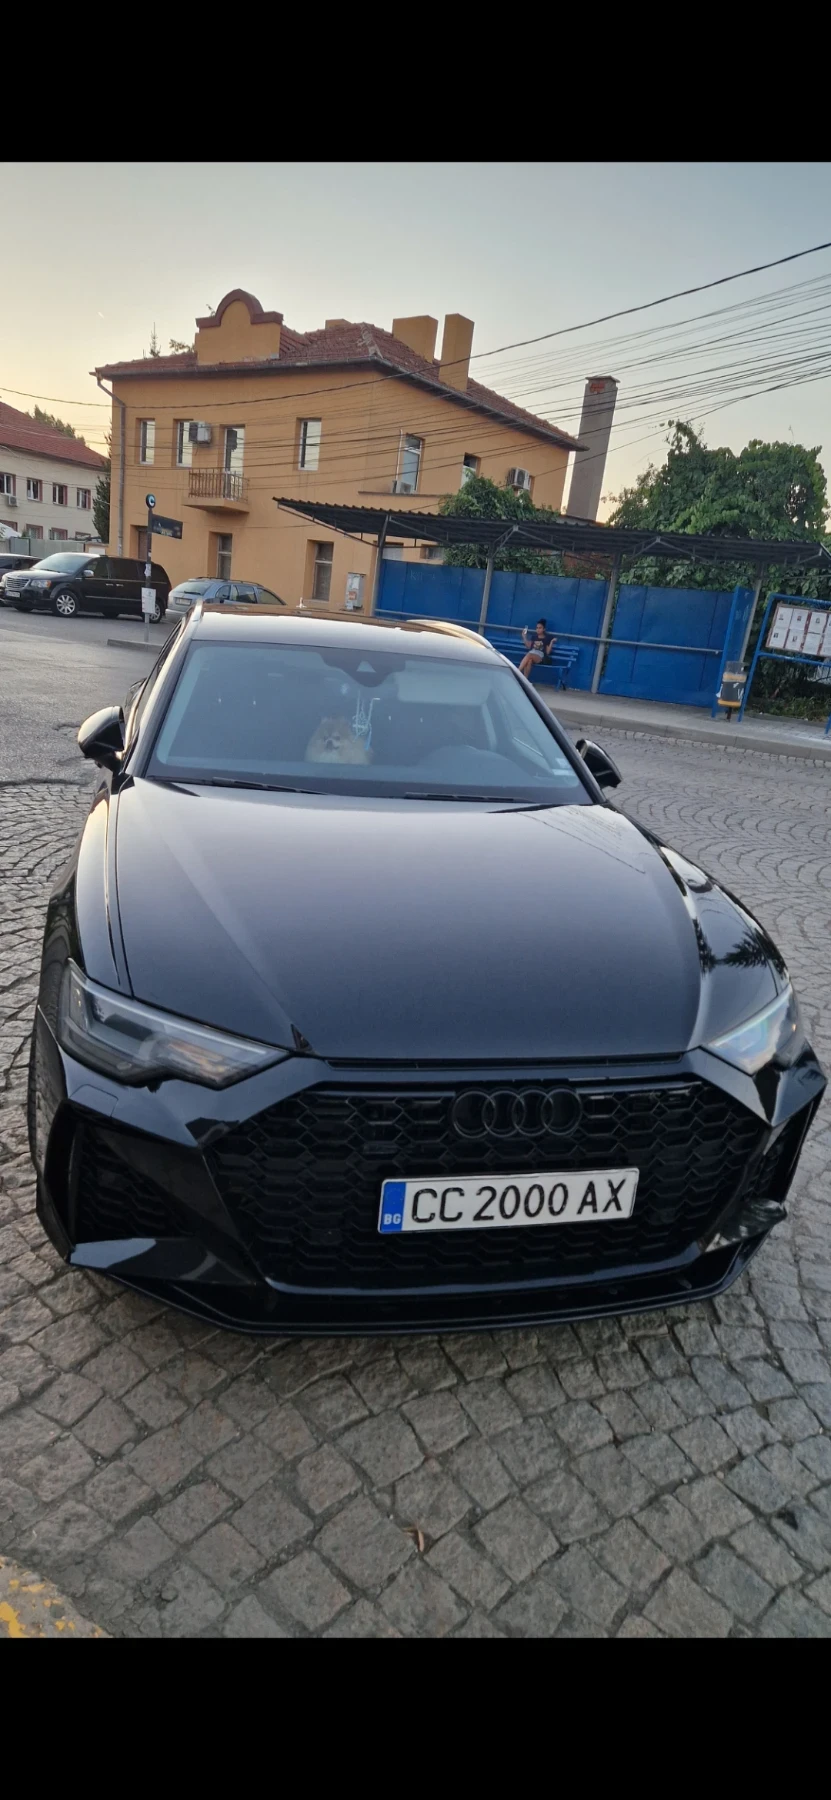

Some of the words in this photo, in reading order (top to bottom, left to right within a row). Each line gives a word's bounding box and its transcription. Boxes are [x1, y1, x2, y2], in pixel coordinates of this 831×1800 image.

[411, 1186, 465, 1224] CC
[472, 1182, 569, 1222] 2000
[576, 1177, 627, 1215] AX
[383, 1213, 402, 1225] BG
